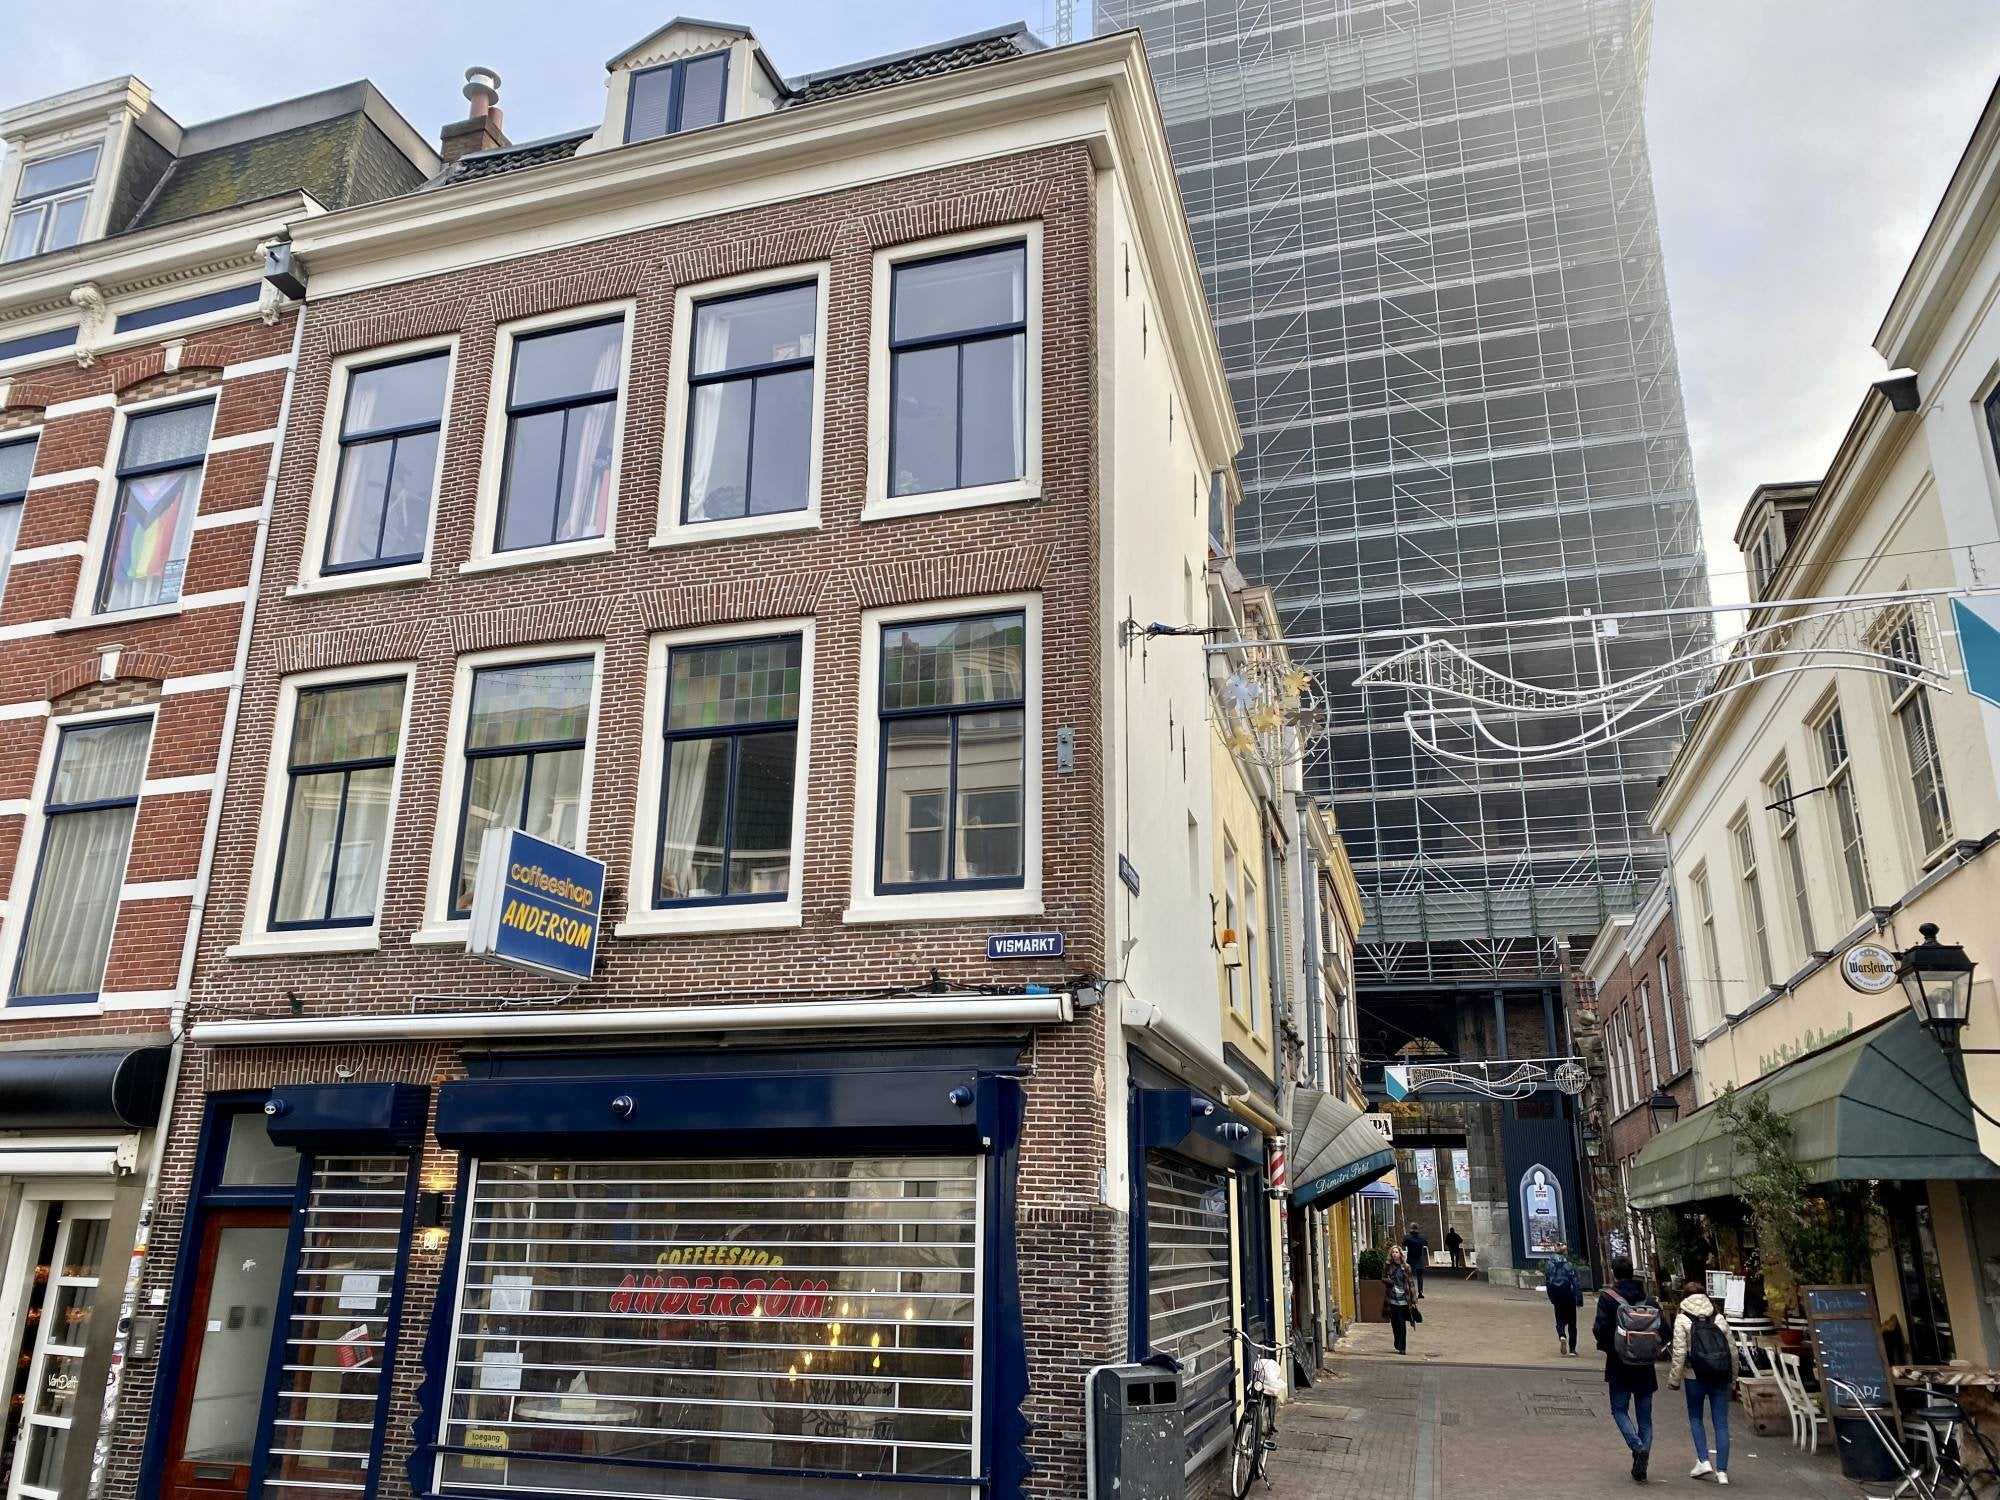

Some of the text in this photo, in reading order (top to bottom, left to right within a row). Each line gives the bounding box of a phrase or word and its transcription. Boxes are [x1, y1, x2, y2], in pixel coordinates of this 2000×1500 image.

[511, 863, 592, 908] coffeeshop
[502, 899, 592, 949] ANDERSOM
[995, 937, 1056, 953] VISMARKT
[1849, 961, 1894, 974] Warsteiner
[1315, 1161, 1370, 1194] Dimitri Petit
[656, 1245, 784, 1268] COFFEESHOP
[608, 1273, 829, 1318] ANDERSOM
[472, 1433, 501, 1443] toegang
